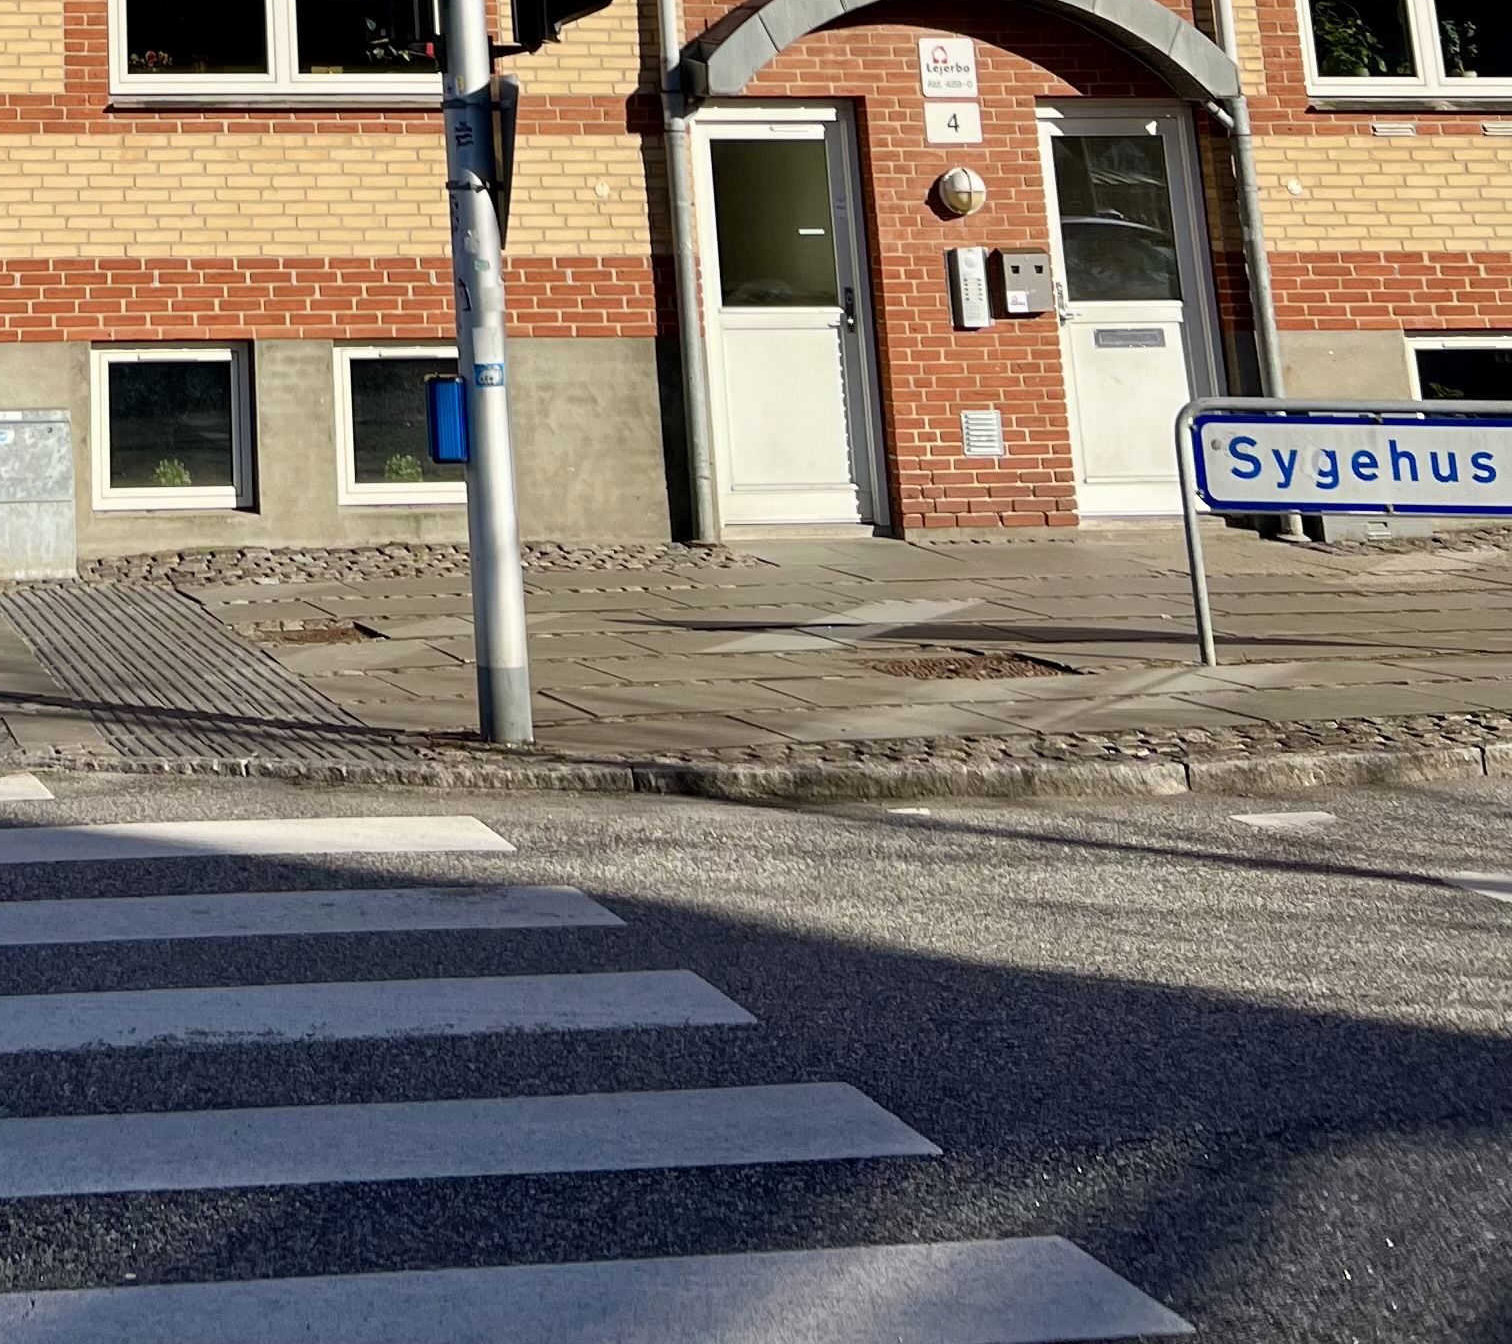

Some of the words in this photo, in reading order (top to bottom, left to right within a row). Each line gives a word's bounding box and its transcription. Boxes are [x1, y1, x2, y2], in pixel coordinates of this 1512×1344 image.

[926, 62, 971, 75] Lejerbo
[947, 112, 960, 133] 4
[1228, 435, 1497, 490] Sygehus
